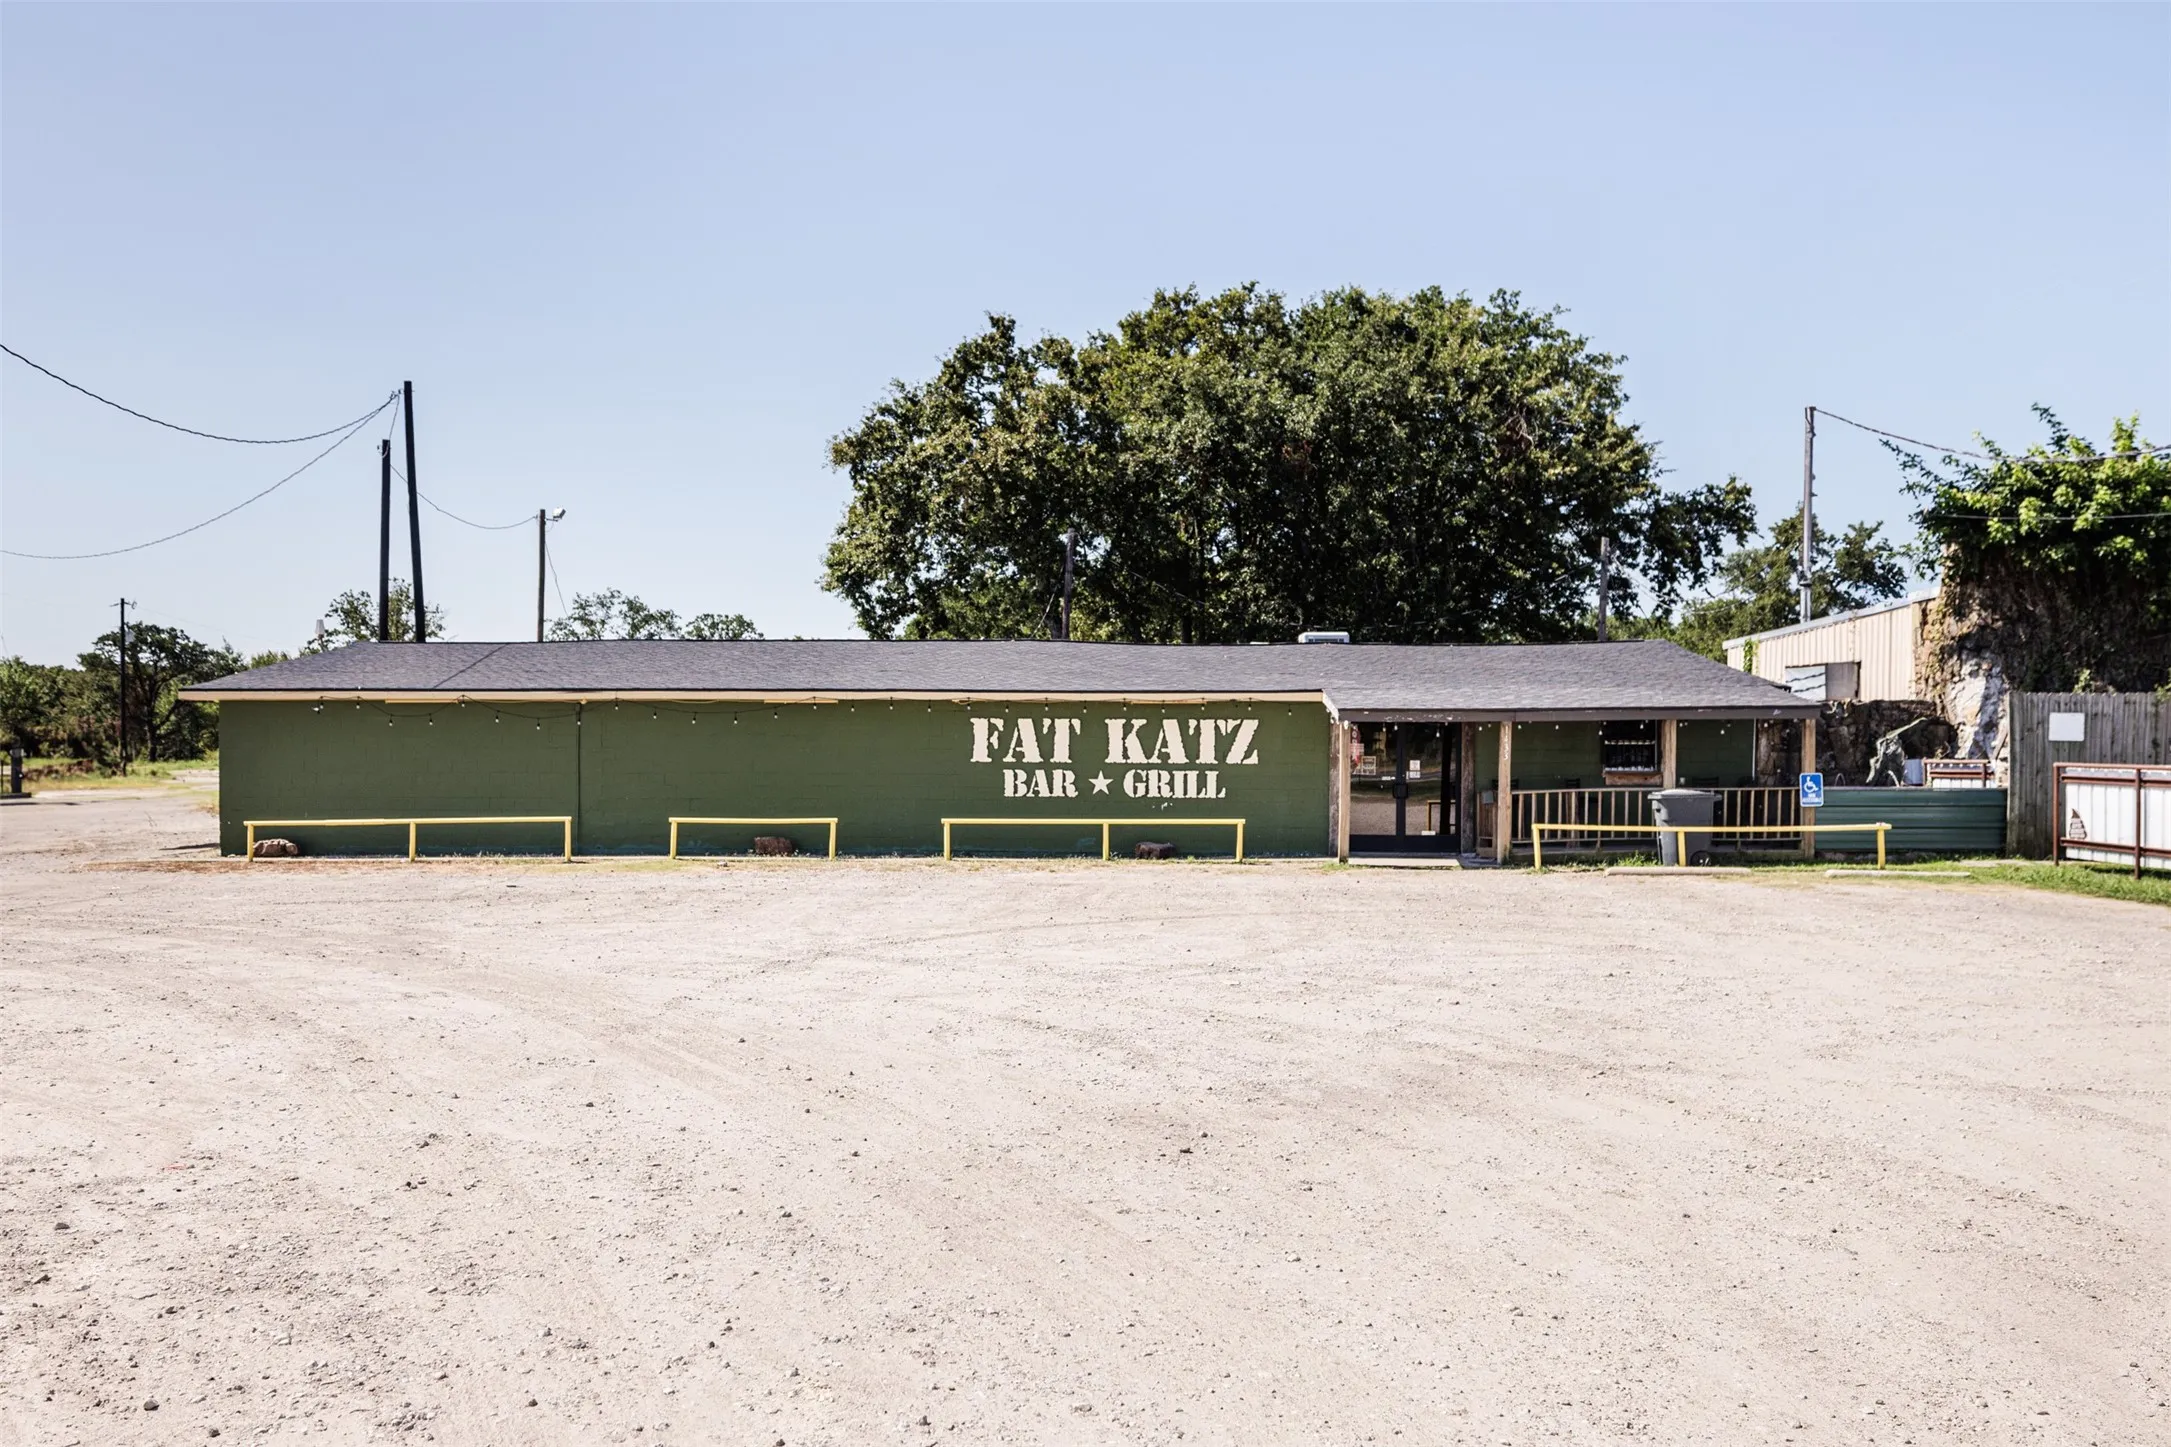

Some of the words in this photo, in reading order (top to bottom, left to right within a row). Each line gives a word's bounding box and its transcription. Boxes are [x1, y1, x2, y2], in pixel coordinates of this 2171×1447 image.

[970, 718, 1081, 763] FAT
[1104, 718, 1259, 764] KATZ
[1003, 769, 1079, 797] BAR
[1123, 769, 1226, 798] GRILL
